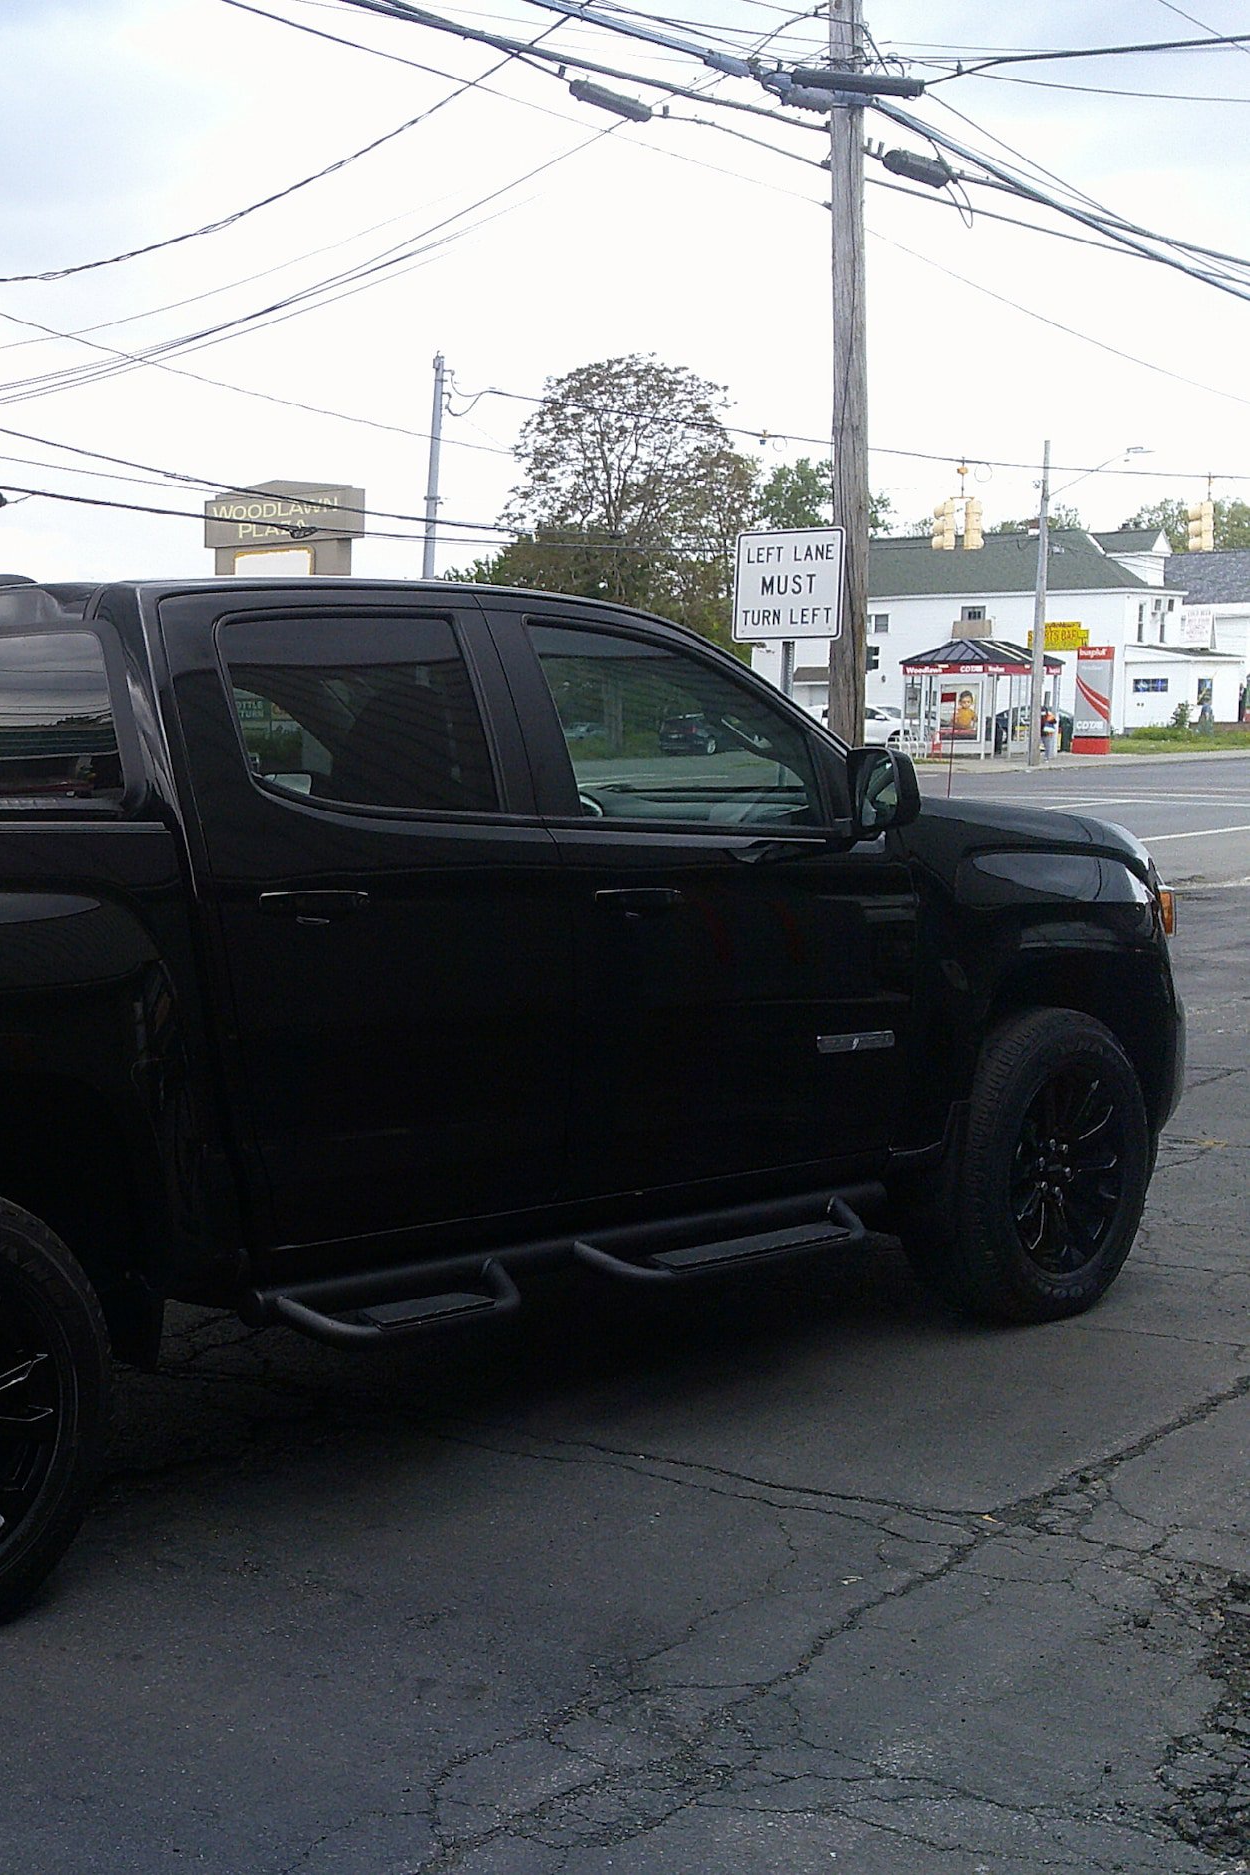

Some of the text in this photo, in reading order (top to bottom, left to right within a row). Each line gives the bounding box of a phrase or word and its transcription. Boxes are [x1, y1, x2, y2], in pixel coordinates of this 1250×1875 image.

[212, 496, 338, 520] WOODLAWN
[747, 543, 835, 564] LEFT LANE
[760, 573, 817, 596] MUST
[742, 607, 832, 626] TURN LEFT
